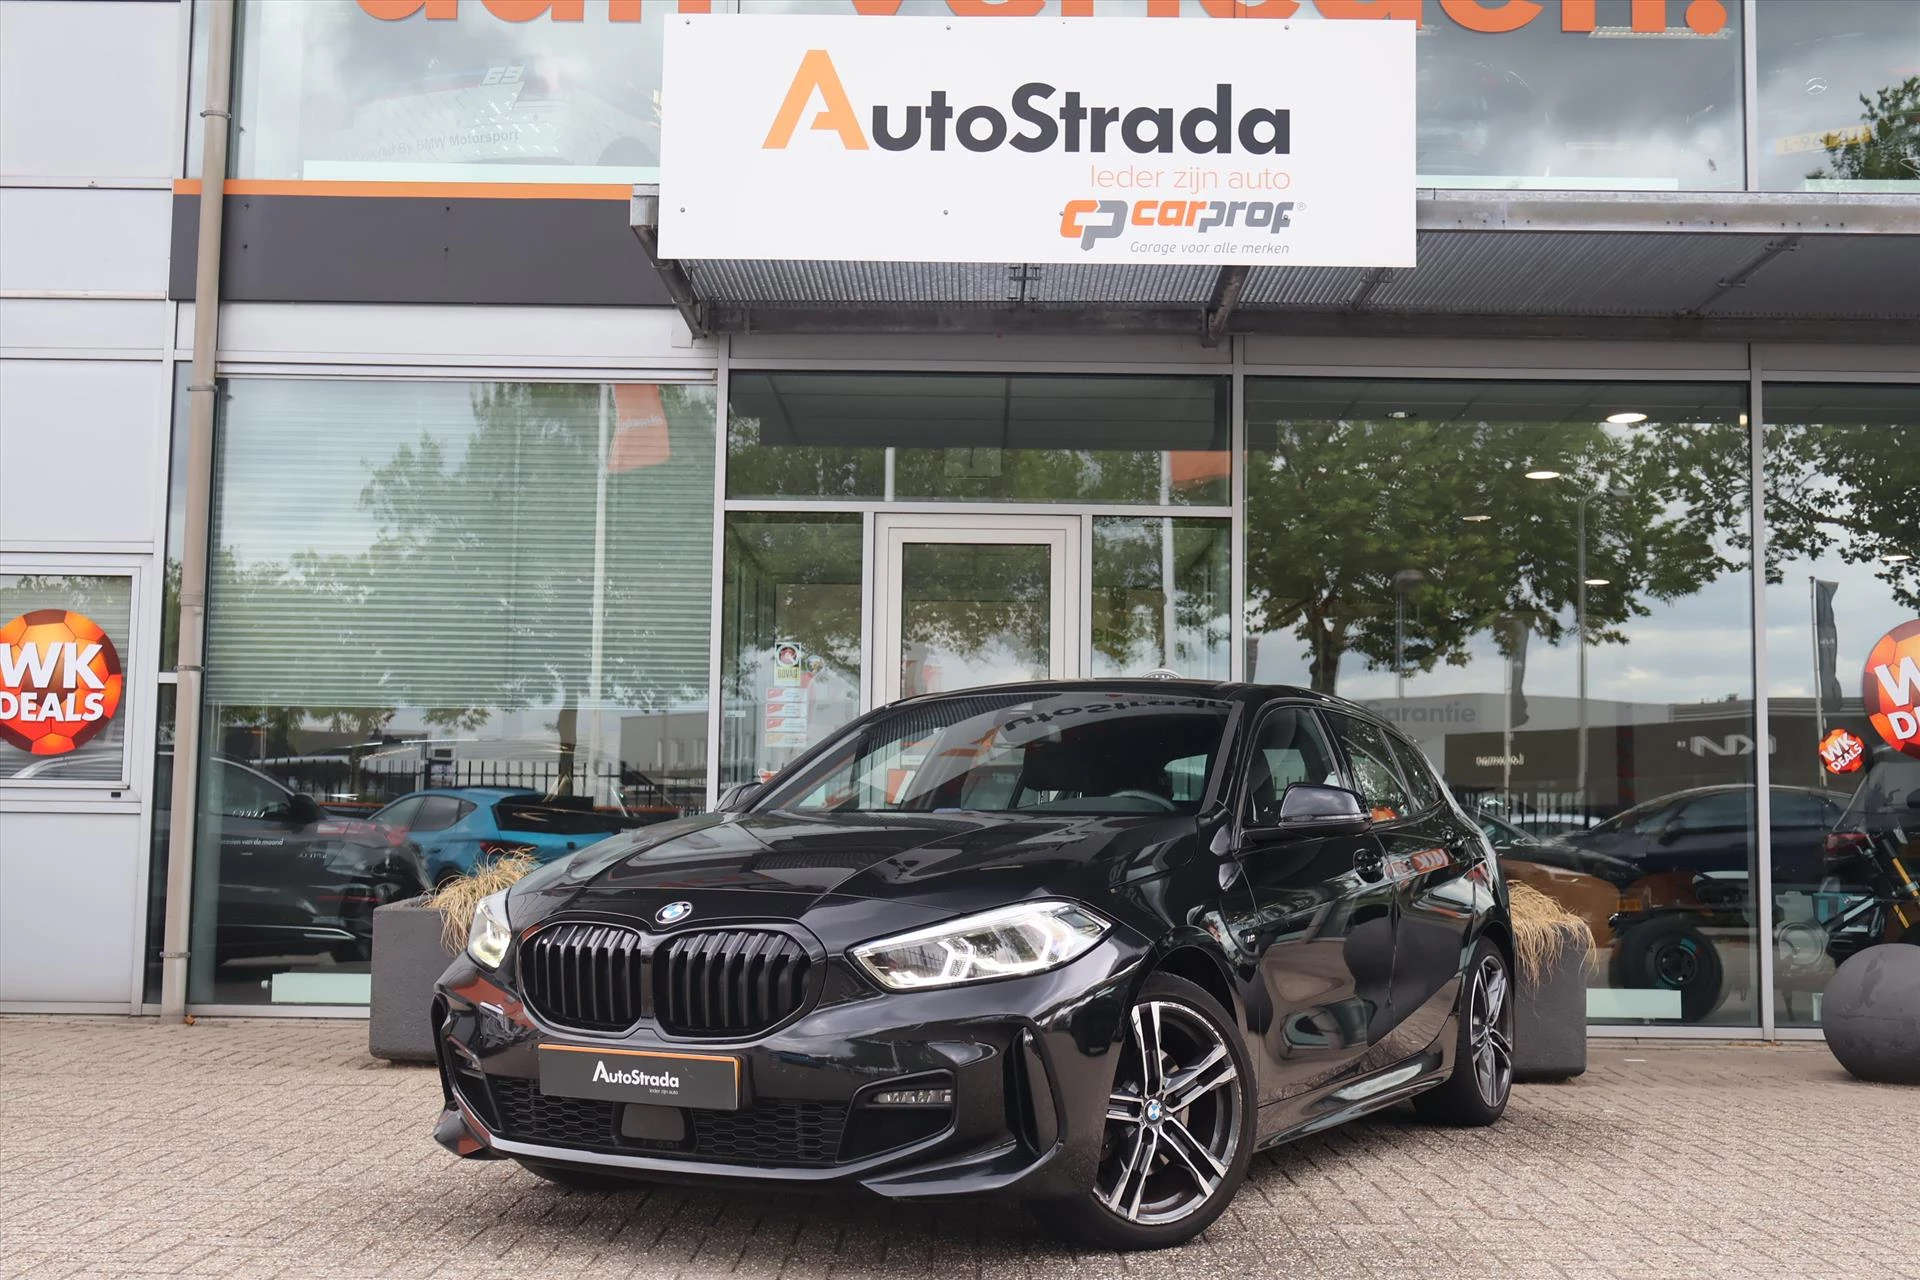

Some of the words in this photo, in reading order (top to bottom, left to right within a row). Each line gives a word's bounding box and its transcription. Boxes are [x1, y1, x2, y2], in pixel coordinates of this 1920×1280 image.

[762, 49, 1291, 155] AutoStrada
[416, 135, 447, 151] BMW
[449, 129, 520, 147] Motorsport
[1090, 165, 1165, 189] Ieder
[1173, 166, 1218, 195] zijn
[1228, 168, 1291, 190] auto
[1130, 241, 1177, 256] Garage
[1181, 244, 1212, 254] voor
[1213, 242, 1237, 255] alle
[1241, 243, 1290, 255] merken
[0, 641, 105, 689] WK
[0, 691, 105, 722] DEALS
[1820, 732, 1857, 762] WK
[1831, 742, 1865, 772] DEALS
[592, 1060, 680, 1088] AutoStrada
